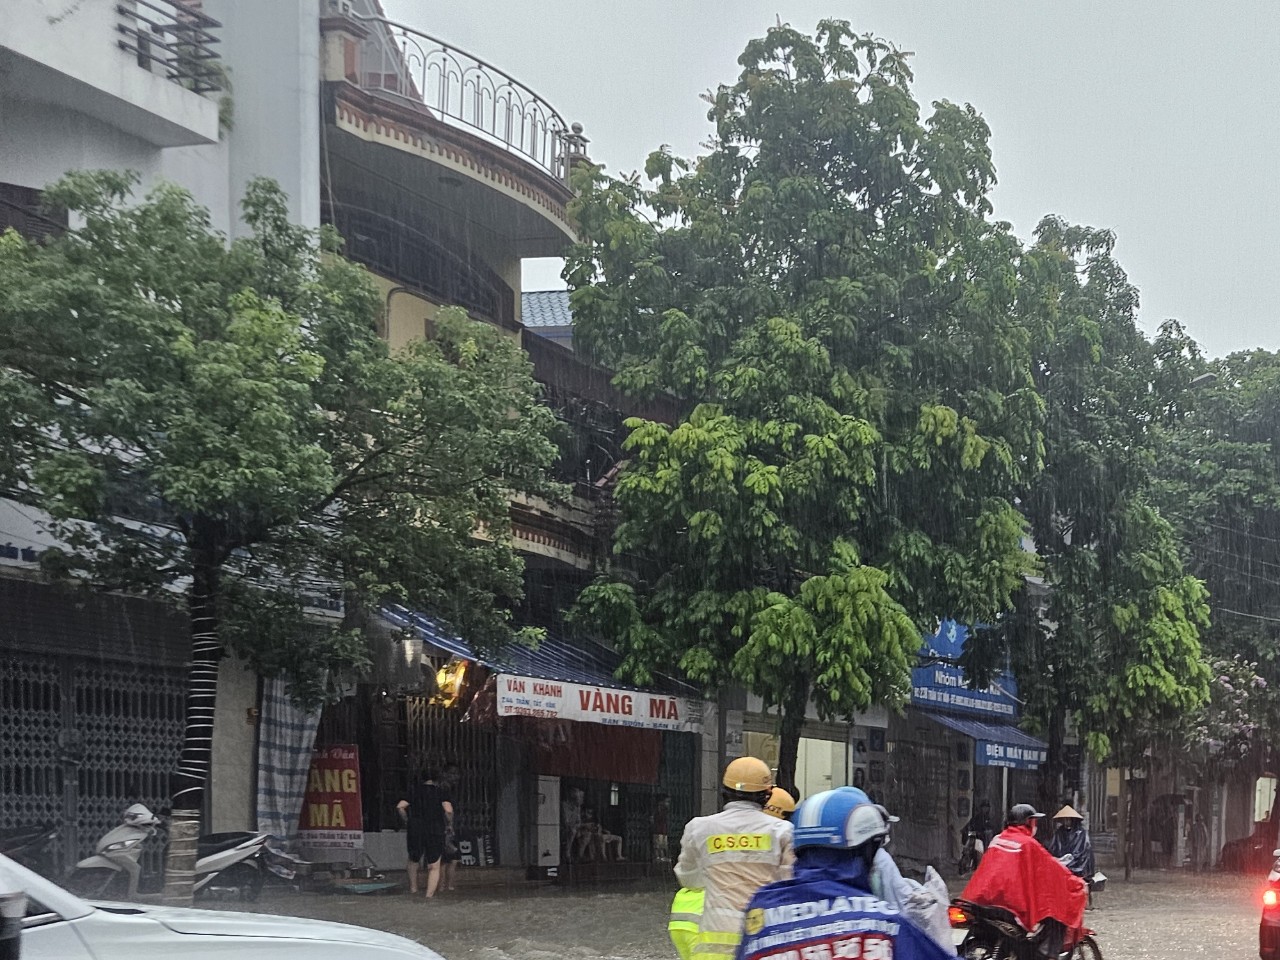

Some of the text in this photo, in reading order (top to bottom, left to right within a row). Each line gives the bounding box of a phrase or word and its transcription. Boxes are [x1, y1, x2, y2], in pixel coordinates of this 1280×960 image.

[507, 677, 563, 698] VÂN KHÁNH
[578, 688, 679, 721] VÀNG MÃ
[308, 763, 358, 794] ÀNG
[308, 799, 347, 828] MÃ
[713, 835, 763, 850] C.S.G.T
